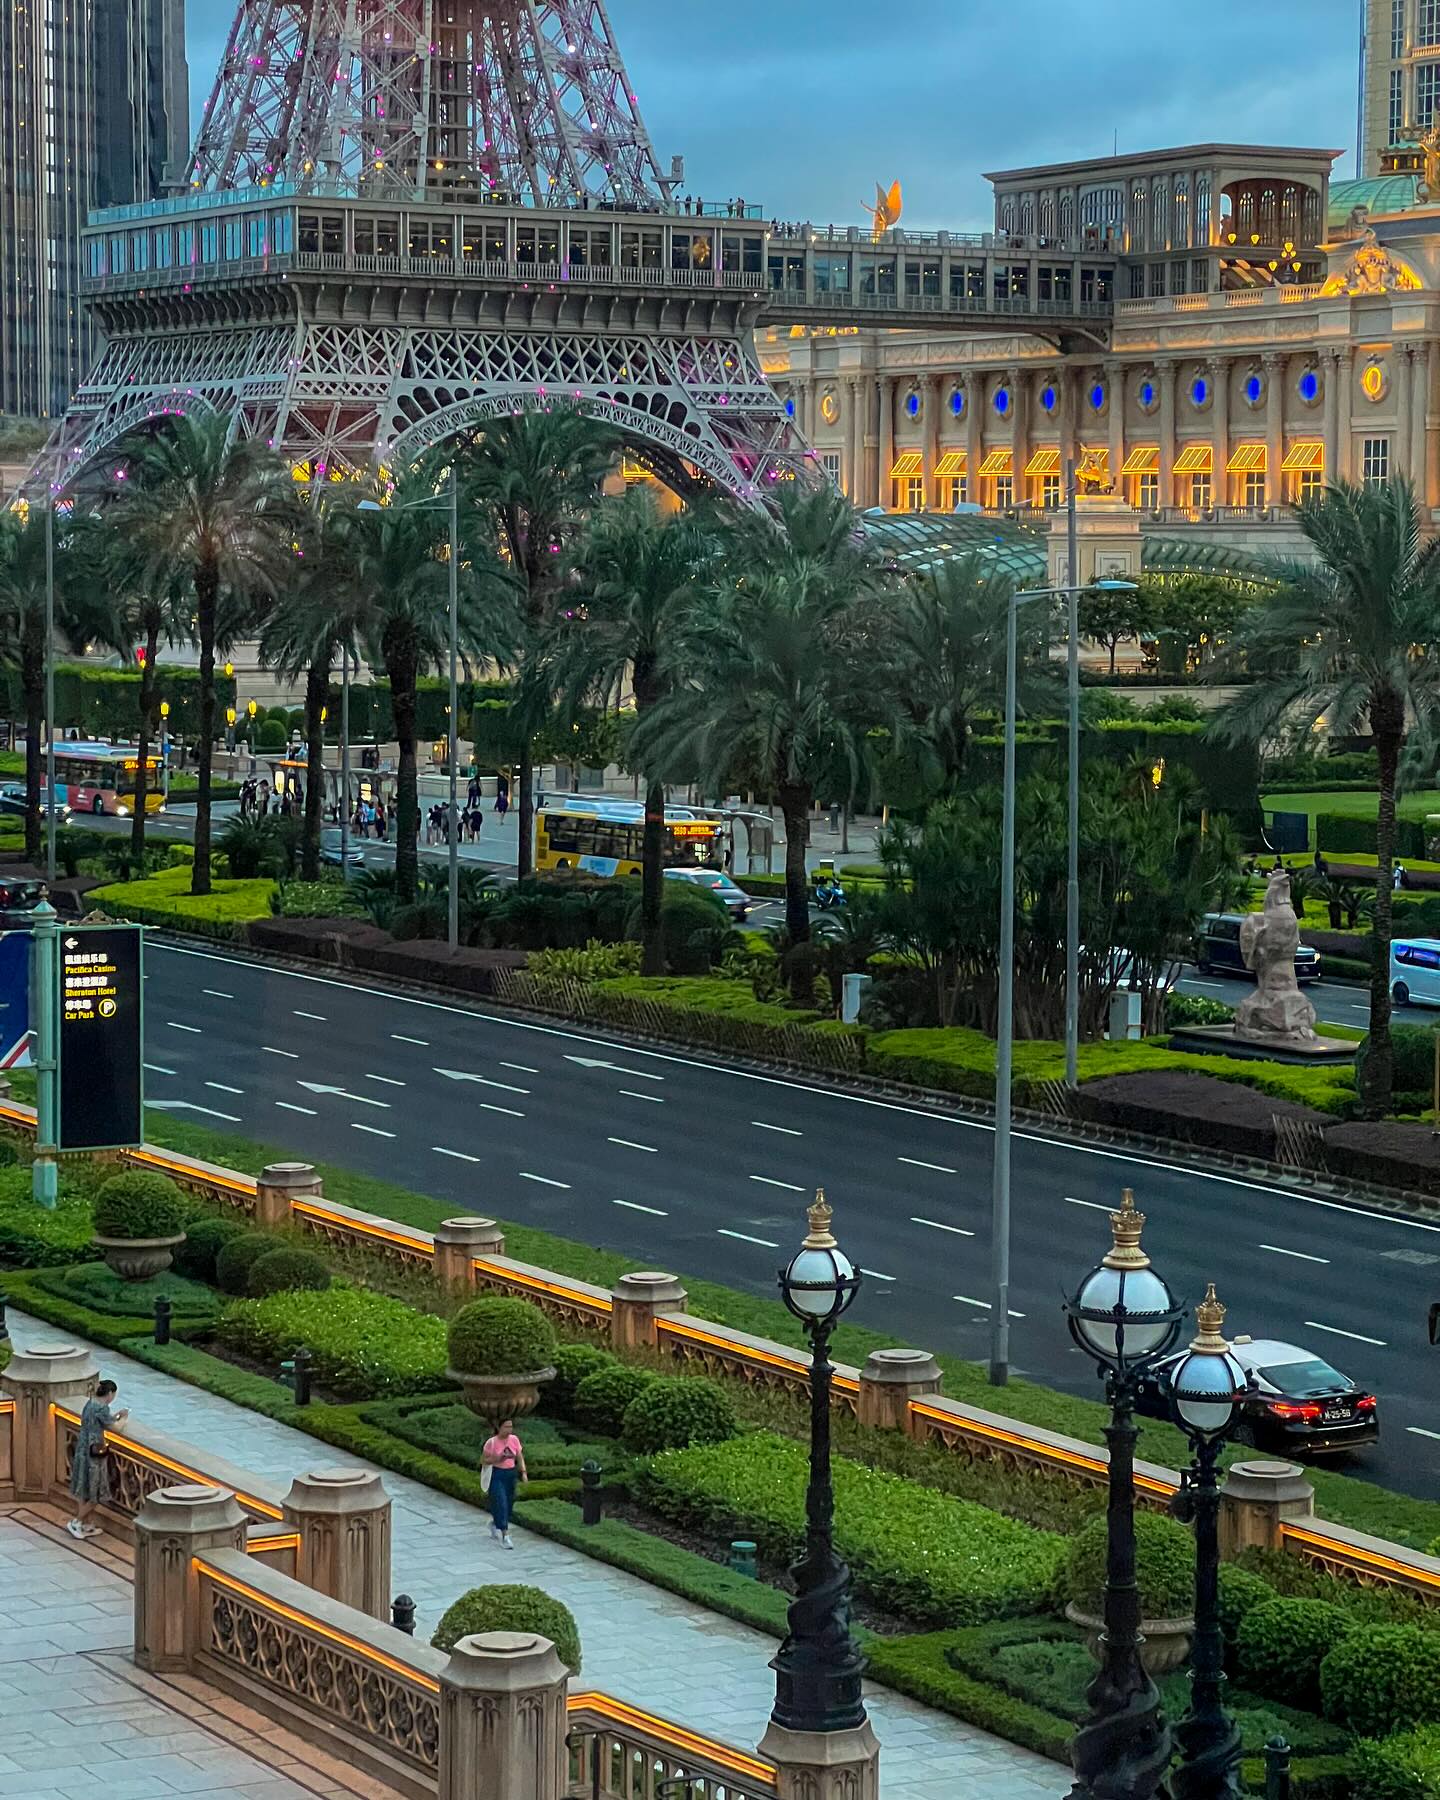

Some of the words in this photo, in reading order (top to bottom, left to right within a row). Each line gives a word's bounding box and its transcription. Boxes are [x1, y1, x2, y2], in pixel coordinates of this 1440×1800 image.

[65, 966, 92, 974] Pacifica
[93, 965, 116, 973] Casino
[98, 987, 116, 995] Hotel
[103, 1001, 114, 1014] P
[65, 1011, 77, 1020] Car
[78, 1011, 94, 1019] Park
